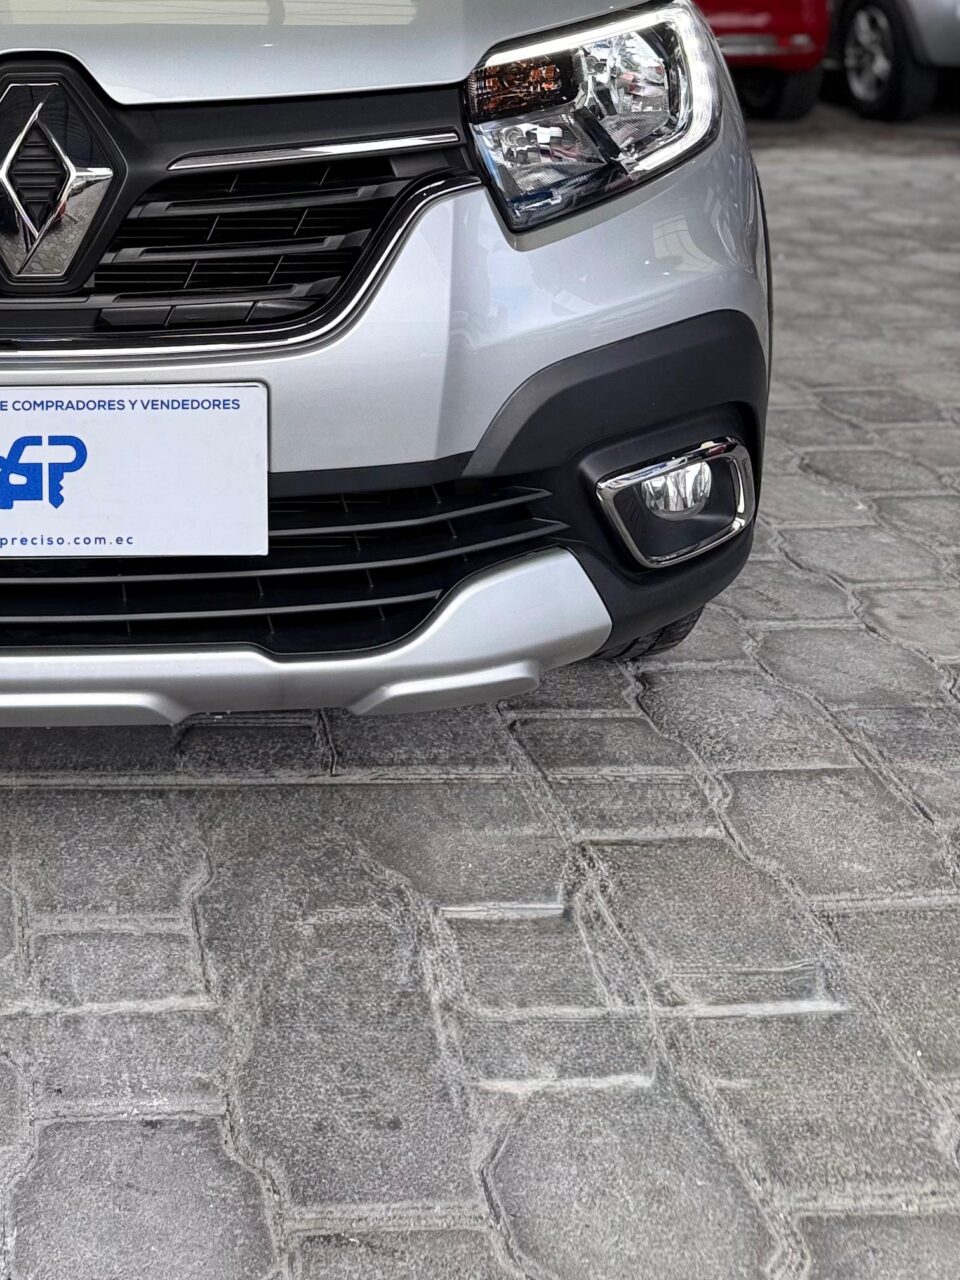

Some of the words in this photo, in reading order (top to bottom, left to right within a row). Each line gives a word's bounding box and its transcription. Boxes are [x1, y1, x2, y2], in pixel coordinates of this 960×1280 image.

[11, 399, 126, 412] COMPRADORES
[128, 399, 139, 411] Y
[140, 398, 241, 411] VENDEDORES
